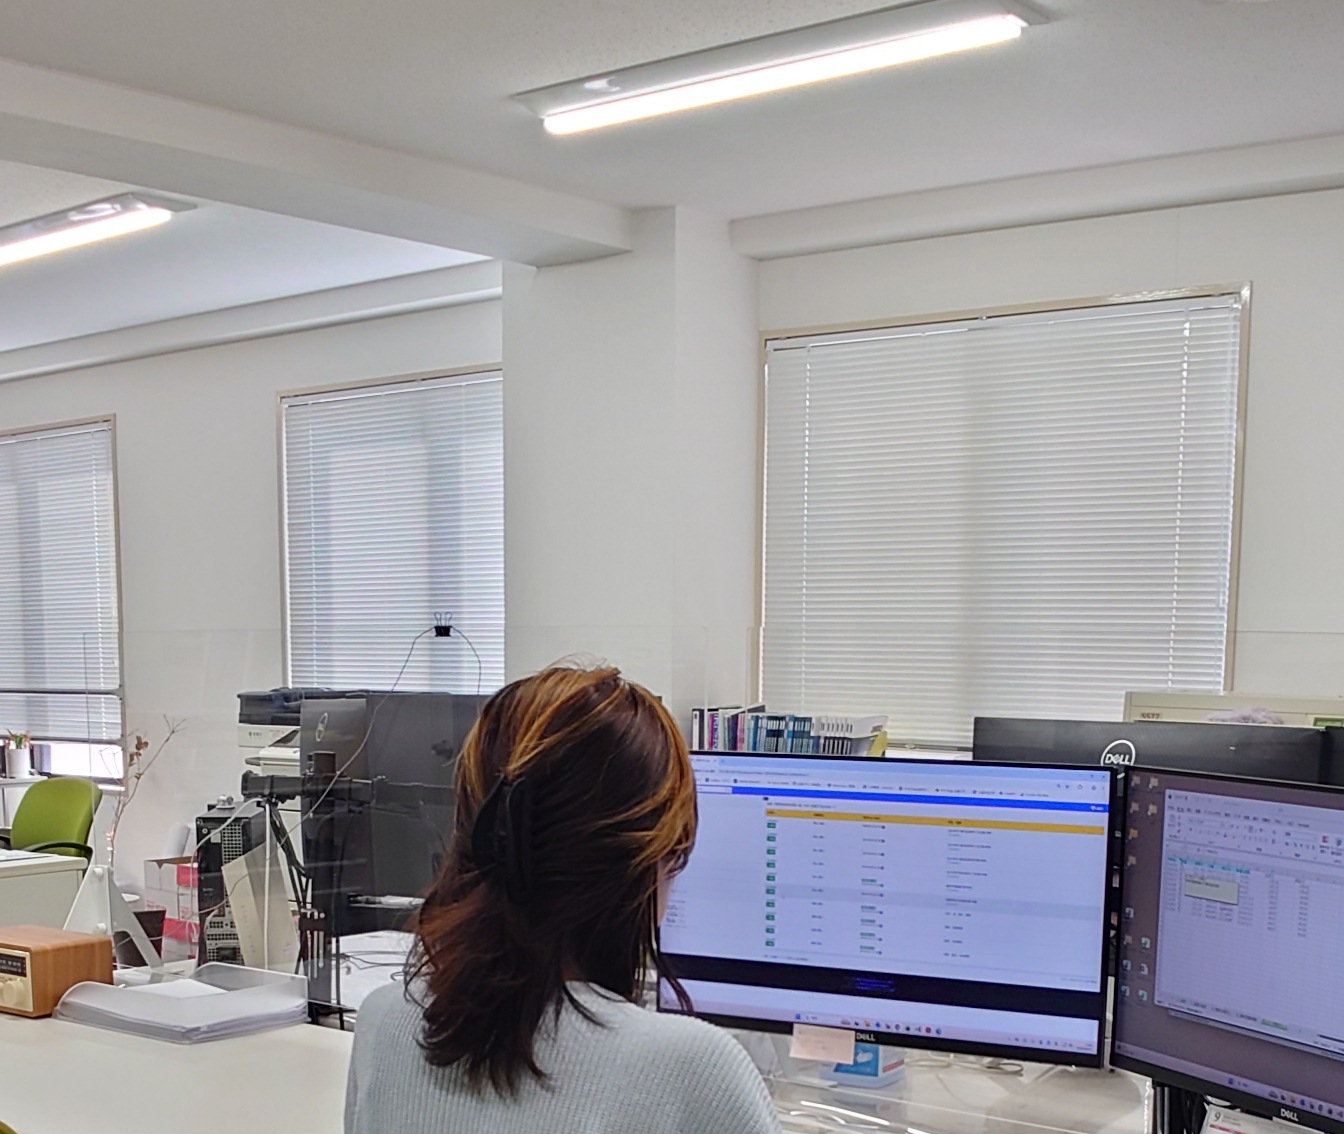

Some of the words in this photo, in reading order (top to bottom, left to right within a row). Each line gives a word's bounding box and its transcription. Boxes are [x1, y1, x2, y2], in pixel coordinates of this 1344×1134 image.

[1104, 753, 1131, 764] DELL
[856, 1032, 876, 1042] DELL
[1213, 1112, 1222, 1122] 9
[1280, 1108, 1300, 1121] DELL
